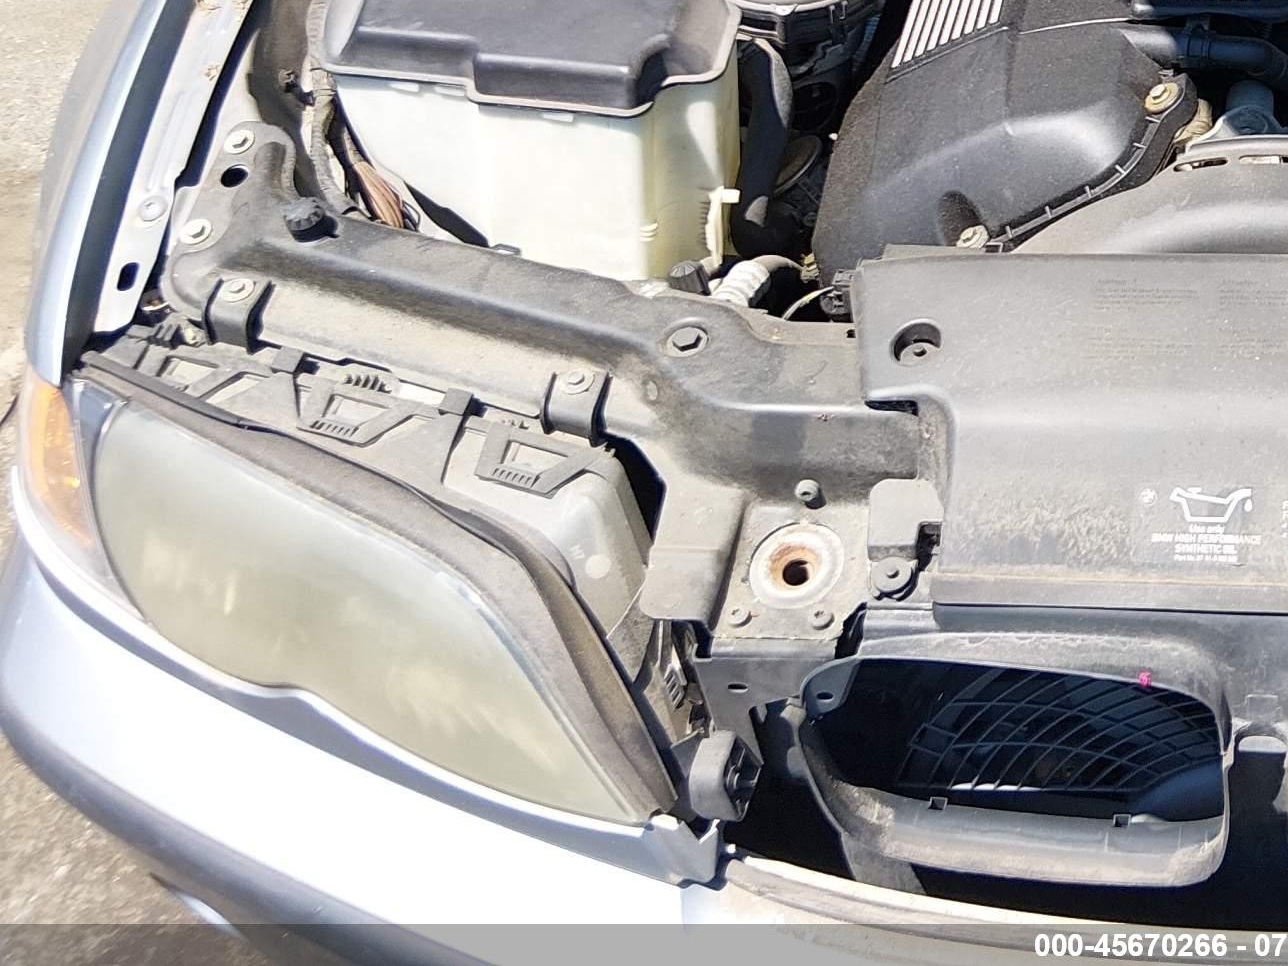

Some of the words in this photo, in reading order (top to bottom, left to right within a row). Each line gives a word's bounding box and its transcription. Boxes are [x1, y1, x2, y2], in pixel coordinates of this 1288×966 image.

[1189, 524, 1205, 533] Use
[1207, 524, 1224, 534] only
[1151, 533, 1173, 542] BMW
[1174, 533, 1196, 543] HIGH
[1197, 534, 1262, 545] PERFORMANCE
[1174, 543, 1221, 554] SYNTHETIC
